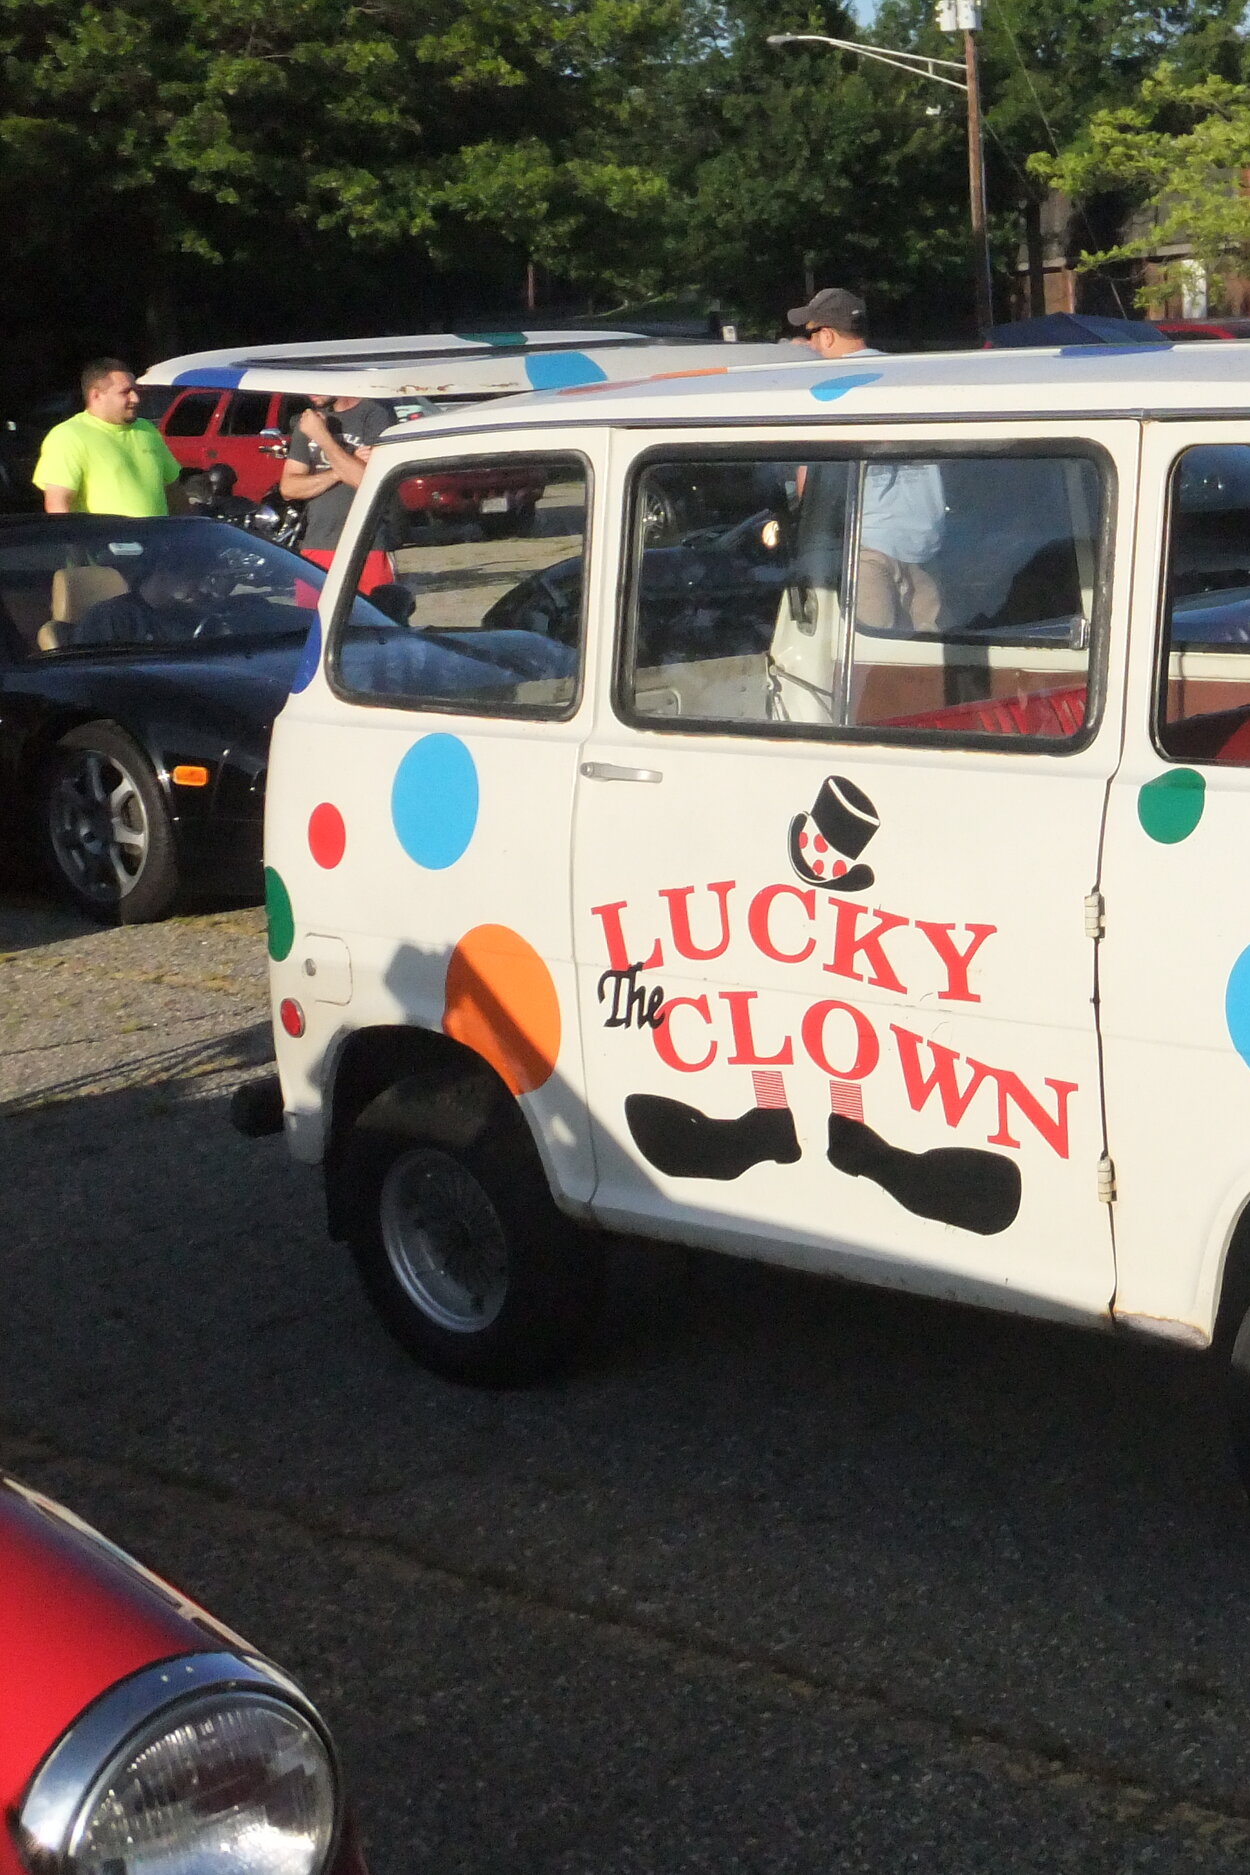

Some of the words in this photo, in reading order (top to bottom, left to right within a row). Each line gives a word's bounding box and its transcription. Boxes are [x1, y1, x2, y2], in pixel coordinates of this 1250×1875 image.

[590, 880, 997, 1003] LUCKY
[597, 961, 666, 1030] The
[651, 990, 1079, 1160] CLOWN
